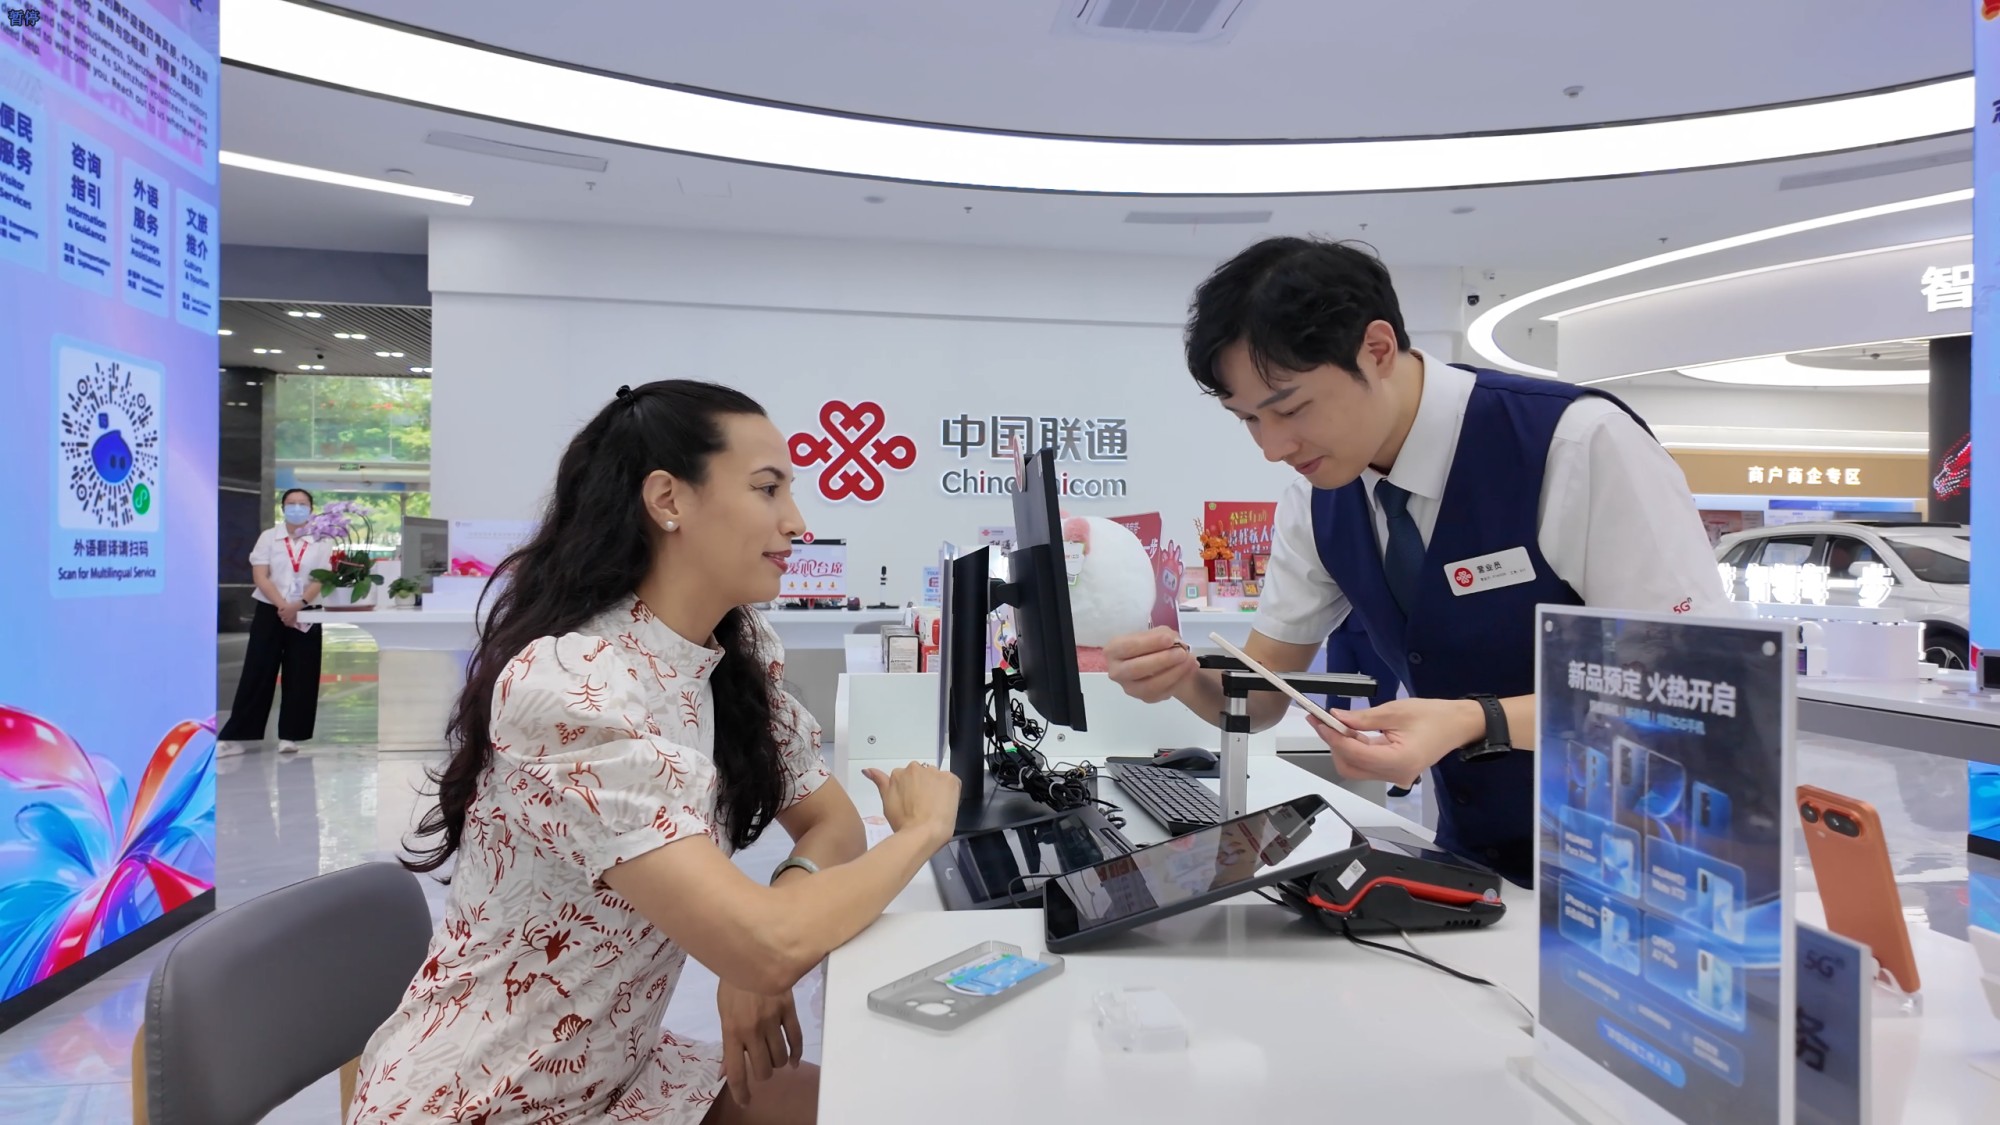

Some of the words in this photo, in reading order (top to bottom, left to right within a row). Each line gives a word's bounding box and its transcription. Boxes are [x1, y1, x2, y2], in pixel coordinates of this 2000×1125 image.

[57, 22, 71, 40] the
[73, 35, 100, 59] world.
[102, 54, 111, 67] As
[113, 60, 149, 93] Shenzhen
[43, 31, 53, 45] to
[55, 41, 91, 71] welcome
[93, 66, 110, 83] you.
[112, 77, 134, 99] Reach
[135, 94, 148, 109] out
[148, 103, 157, 115] to
[157, 110, 166, 121] us
[166, 115, 197, 139] whenever
[196, 136, 208, 149] you
[127, 53, 158, 83] Shenzhen
[158, 79, 188, 107] welcomes
[0, 102, 33, 144] 便民
[0, 136, 33, 175] 服务
[71, 141, 102, 179] 咨询
[0, 171, 25, 192] Visitor
[71, 175, 101, 210] 指引
[133, 177, 159, 209] 外语
[66, 203, 107, 230] Information
[68, 218, 73, 229] &
[74, 221, 107, 243] Guidance
[133, 206, 159, 237] 服务
[186, 207, 209, 236] 文旅
[131, 233, 159, 254] Language
[131, 247, 161, 268] Assistance
[185, 233, 208, 261] 推介
[184, 259, 202, 273] Culture
[190, 272, 210, 289] Tourism
[1920, 264, 1974, 312] 智
[942, 414, 1128, 461] 中国联通
[1747, 466, 1862, 486] 商户商企专区
[74, 538, 149, 557] 外语翻译请扫码
[58, 567, 77, 581] Scan
[78, 567, 89, 580] for
[90, 566, 133, 582] Multilingual
[133, 565, 156, 578] Service
[1567, 660, 1643, 700] 新品预定
[1646, 672, 1737, 719] 火热开启
